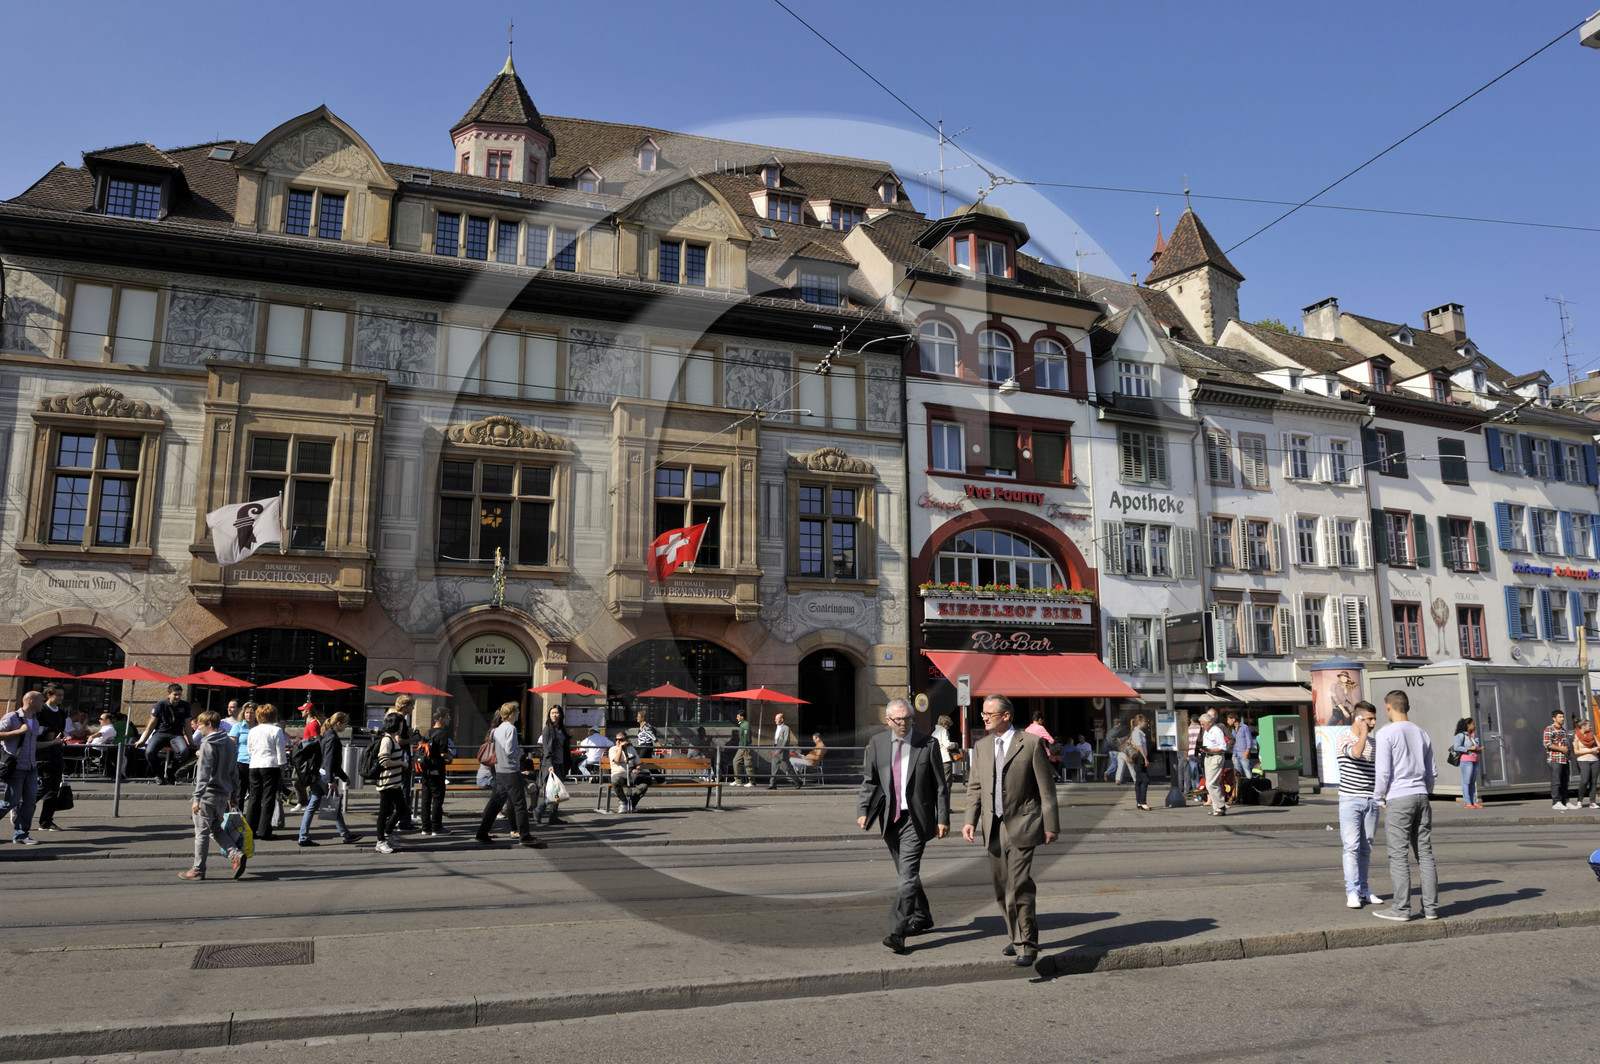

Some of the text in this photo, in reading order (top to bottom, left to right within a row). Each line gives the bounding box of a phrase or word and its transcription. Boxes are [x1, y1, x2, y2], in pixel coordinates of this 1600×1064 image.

[965, 484, 1045, 506] Vve Fourny
[1109, 490, 1184, 514] Apotheke
[265, 563, 301, 571] BRAUEREI
[649, 586, 730, 598] ZUM BRAUNEN MUTZ
[1394, 589, 1422, 598] BODEGA
[1454, 592, 1479, 600] STRAUSS
[808, 602, 855, 615] Saaleingang
[937, 602, 1083, 620] ZIEGELHOF BIER
[971, 630, 1054, 651] Rio Bar
[1217, 621, 1225, 659] Apotheke
[475, 656, 506, 665] MUTZ
[1405, 676, 1424, 687] WC
